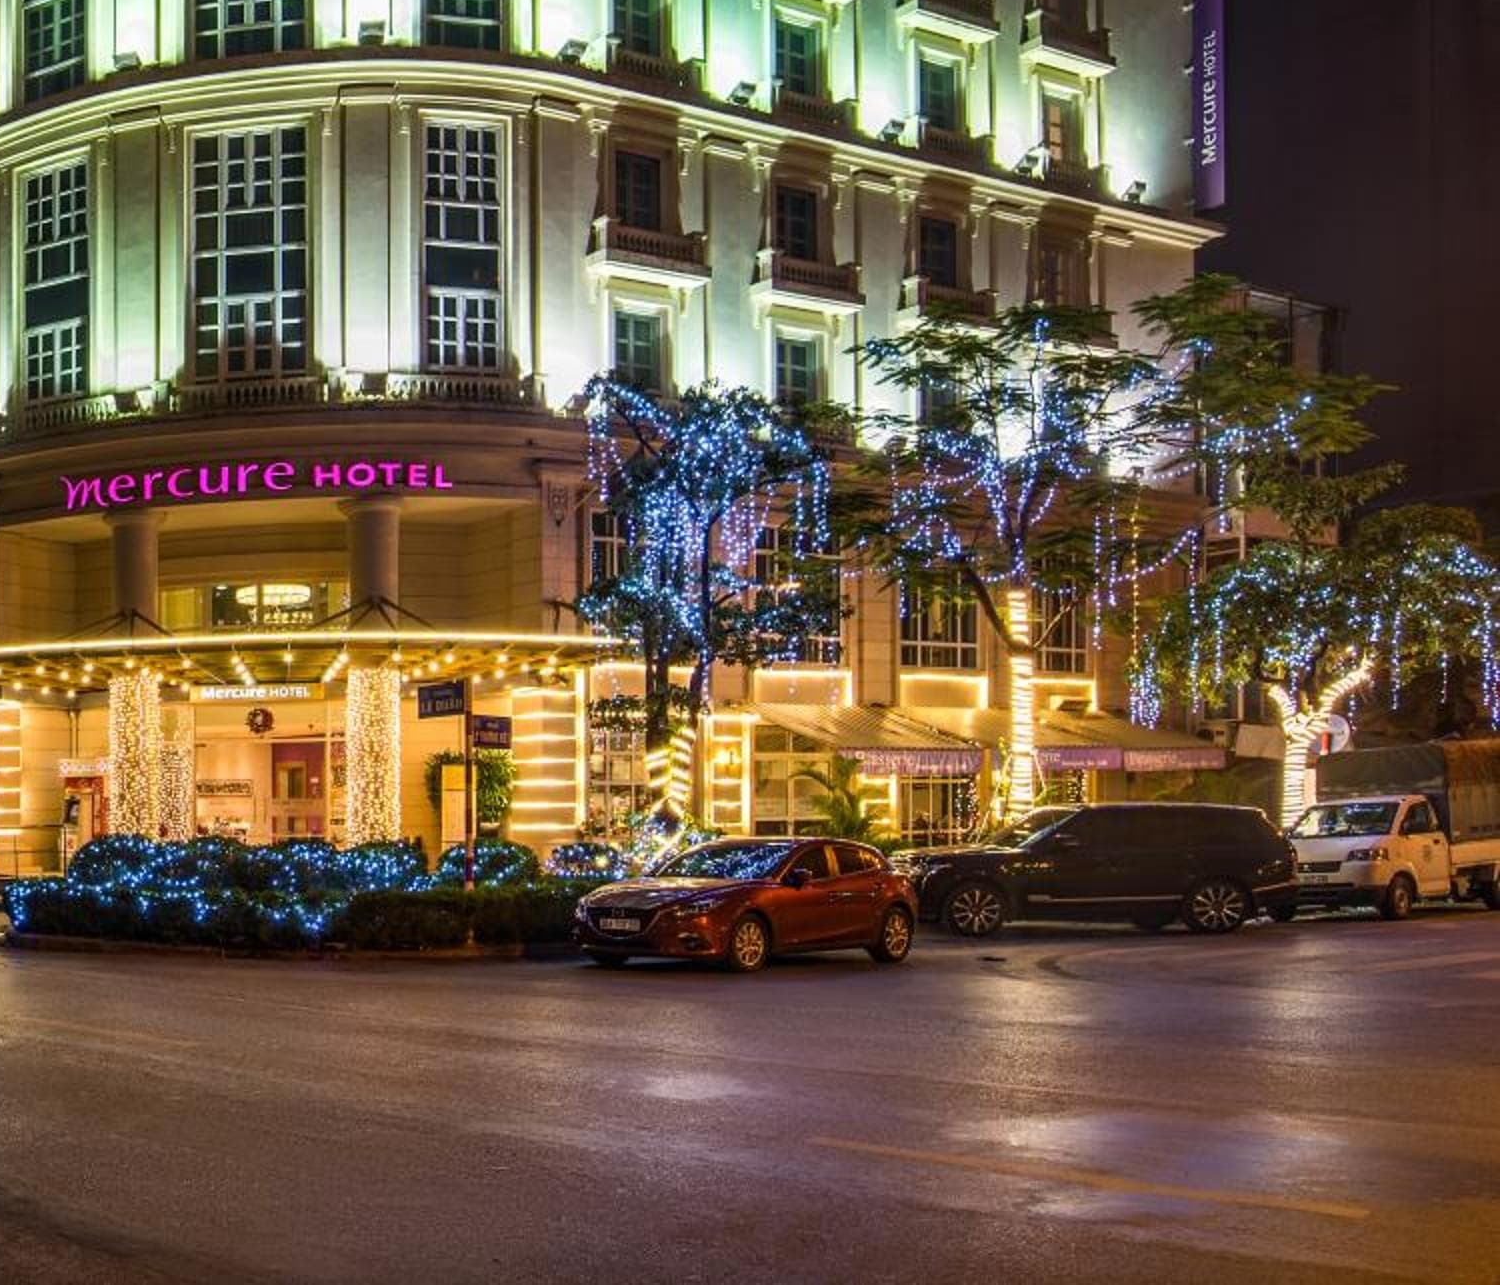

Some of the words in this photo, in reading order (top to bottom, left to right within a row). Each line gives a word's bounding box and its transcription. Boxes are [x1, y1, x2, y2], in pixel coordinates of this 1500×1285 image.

[1203, 29, 1217, 78] HOTEL
[1201, 79, 1217, 166] Mercure
[313, 462, 453, 489] HOTEL
